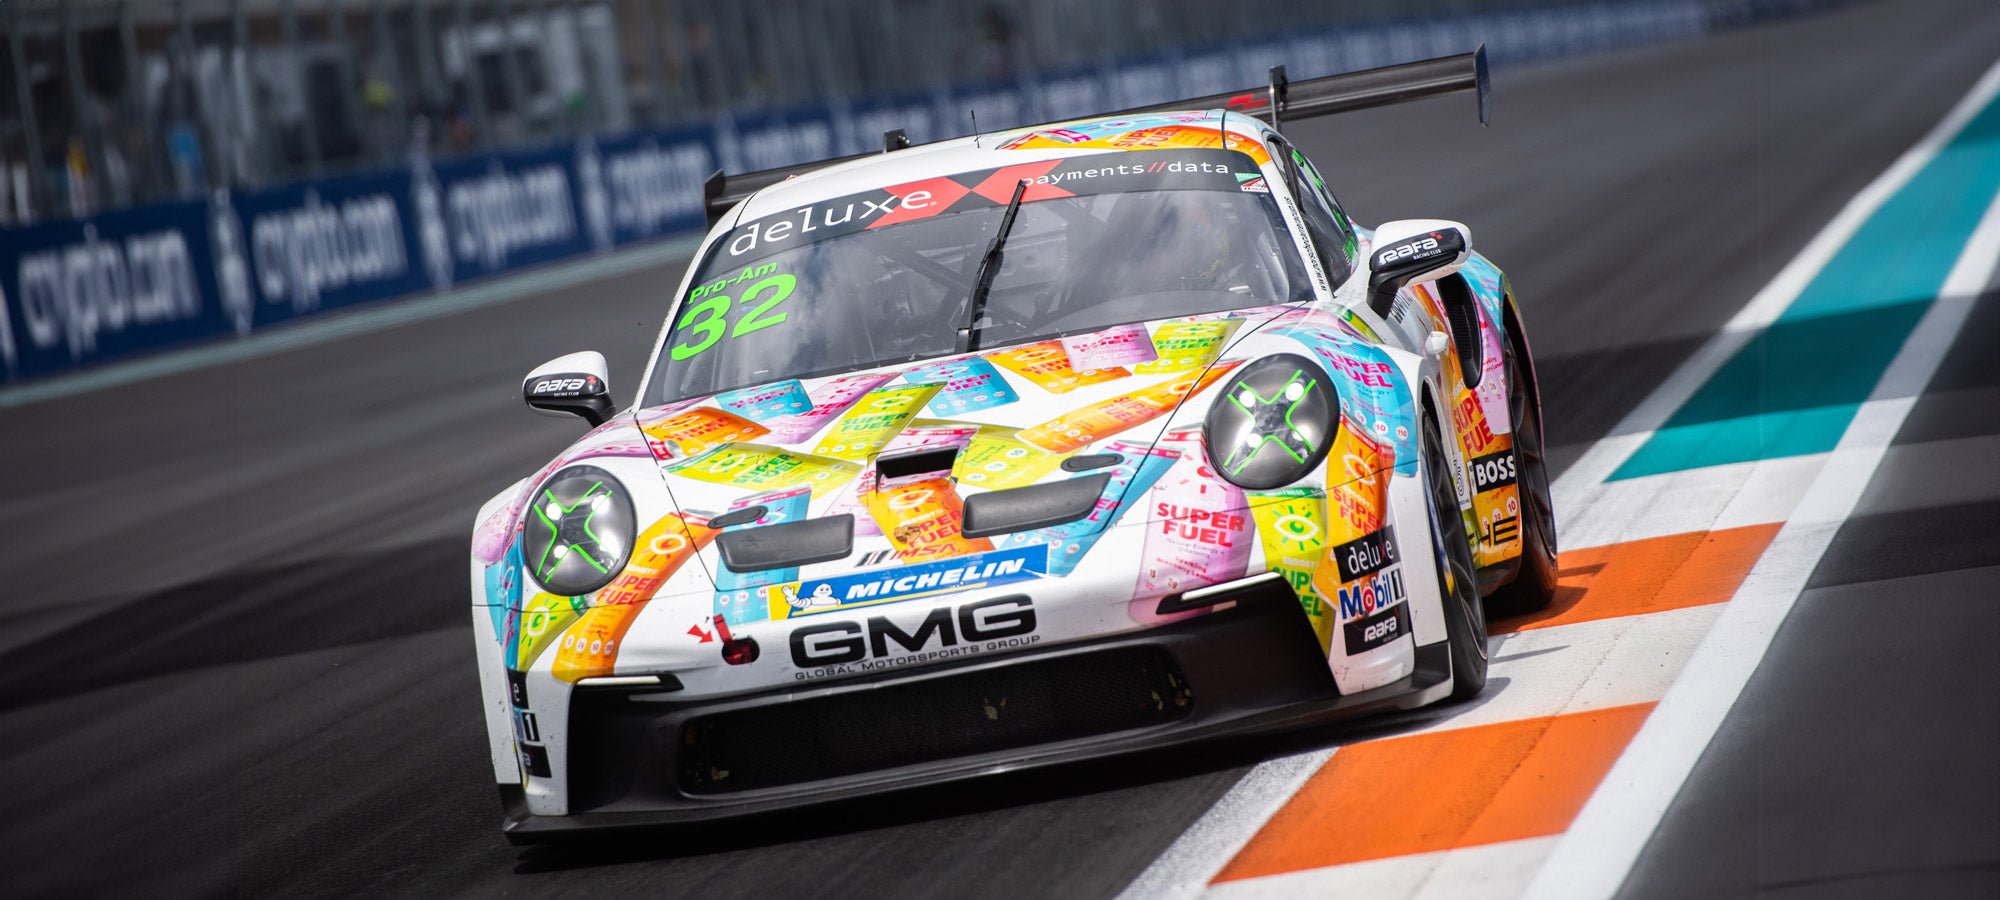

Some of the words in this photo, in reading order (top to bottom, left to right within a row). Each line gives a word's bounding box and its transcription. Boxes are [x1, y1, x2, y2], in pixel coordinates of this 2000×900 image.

[729, 189, 932, 257] deluxe
[688, 262, 778, 305] Pro-Am
[671, 273, 797, 361] 32
[841, 420, 894, 432] FUEL
[842, 412, 909, 426] SUPER
[1475, 454, 1515, 487] BOSS
[1157, 502, 1245, 532] SUPER
[1508, 500, 1516, 512] 10
[1163, 520, 1233, 548] FUEL
[1348, 540, 1394, 575] deluxe
[612, 574, 660, 593] UPER
[846, 558, 1025, 600] MICHELIN
[1339, 573, 1393, 620] Mobil
[789, 592, 1037, 668] GMG
[795, 663, 855, 681] GLOBAL
[861, 644, 980, 670] MOTORSPORTS
[986, 635, 1041, 651] GROUP
